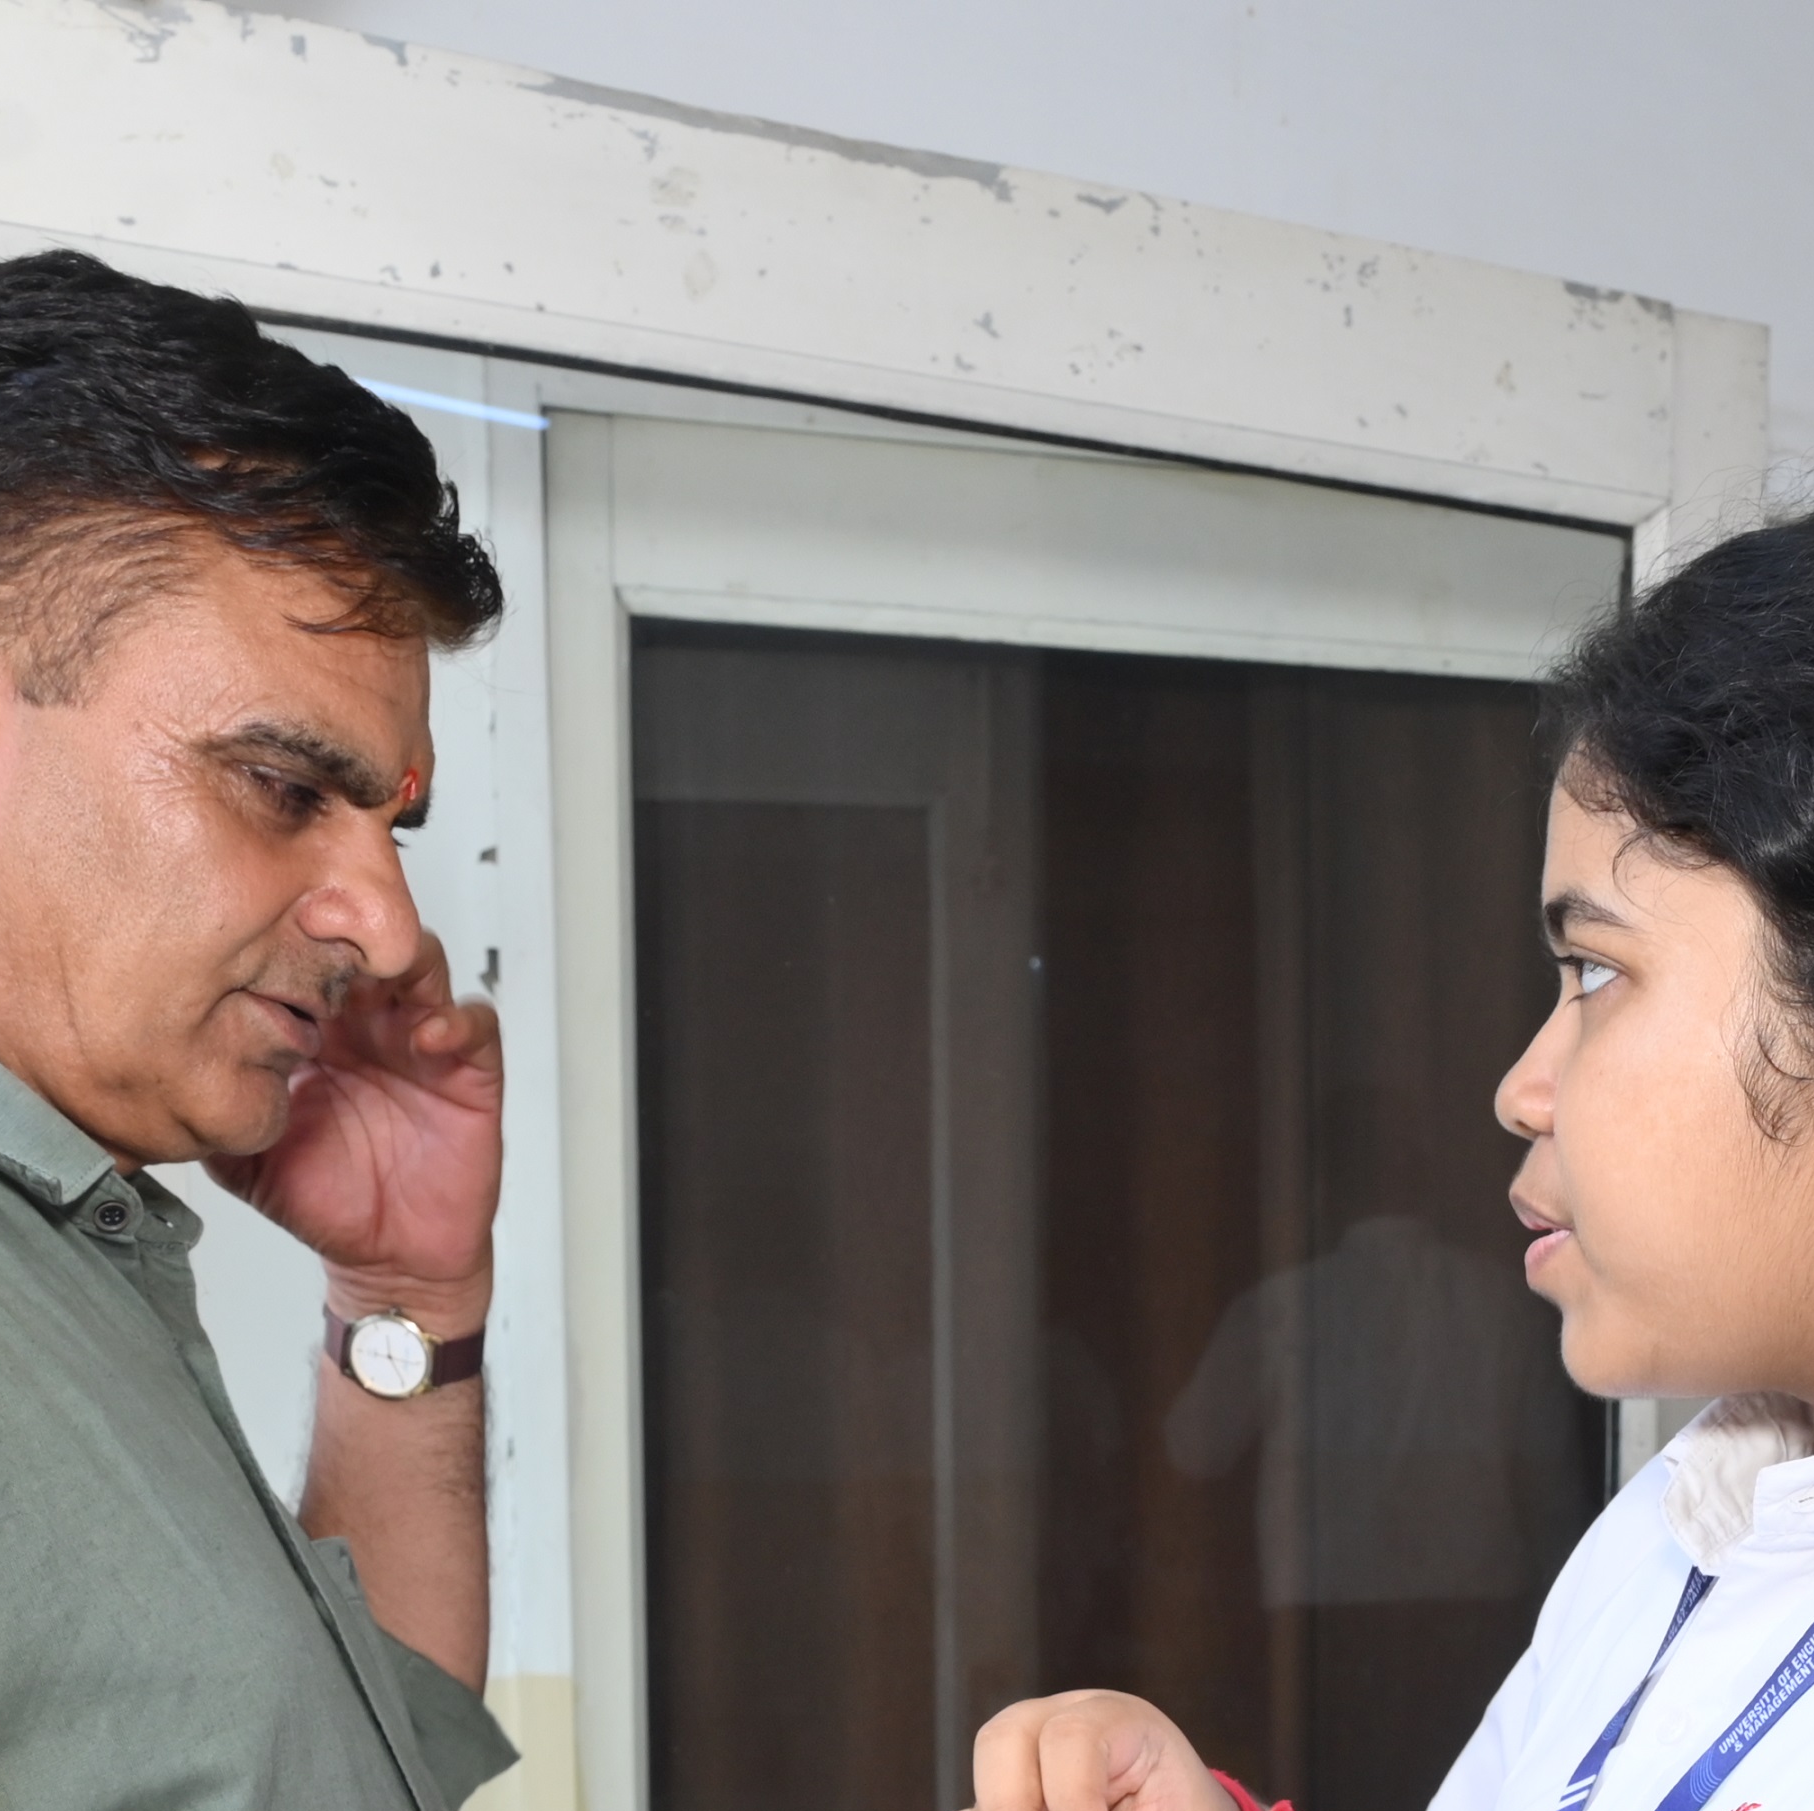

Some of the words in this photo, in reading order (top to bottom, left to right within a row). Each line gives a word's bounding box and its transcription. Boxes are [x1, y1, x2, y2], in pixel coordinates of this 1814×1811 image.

[1718, 1684, 1777, 1754] UNIVERSITY
[1778, 1667, 1793, 1687] OF
[1734, 1740, 1744, 1752] &
